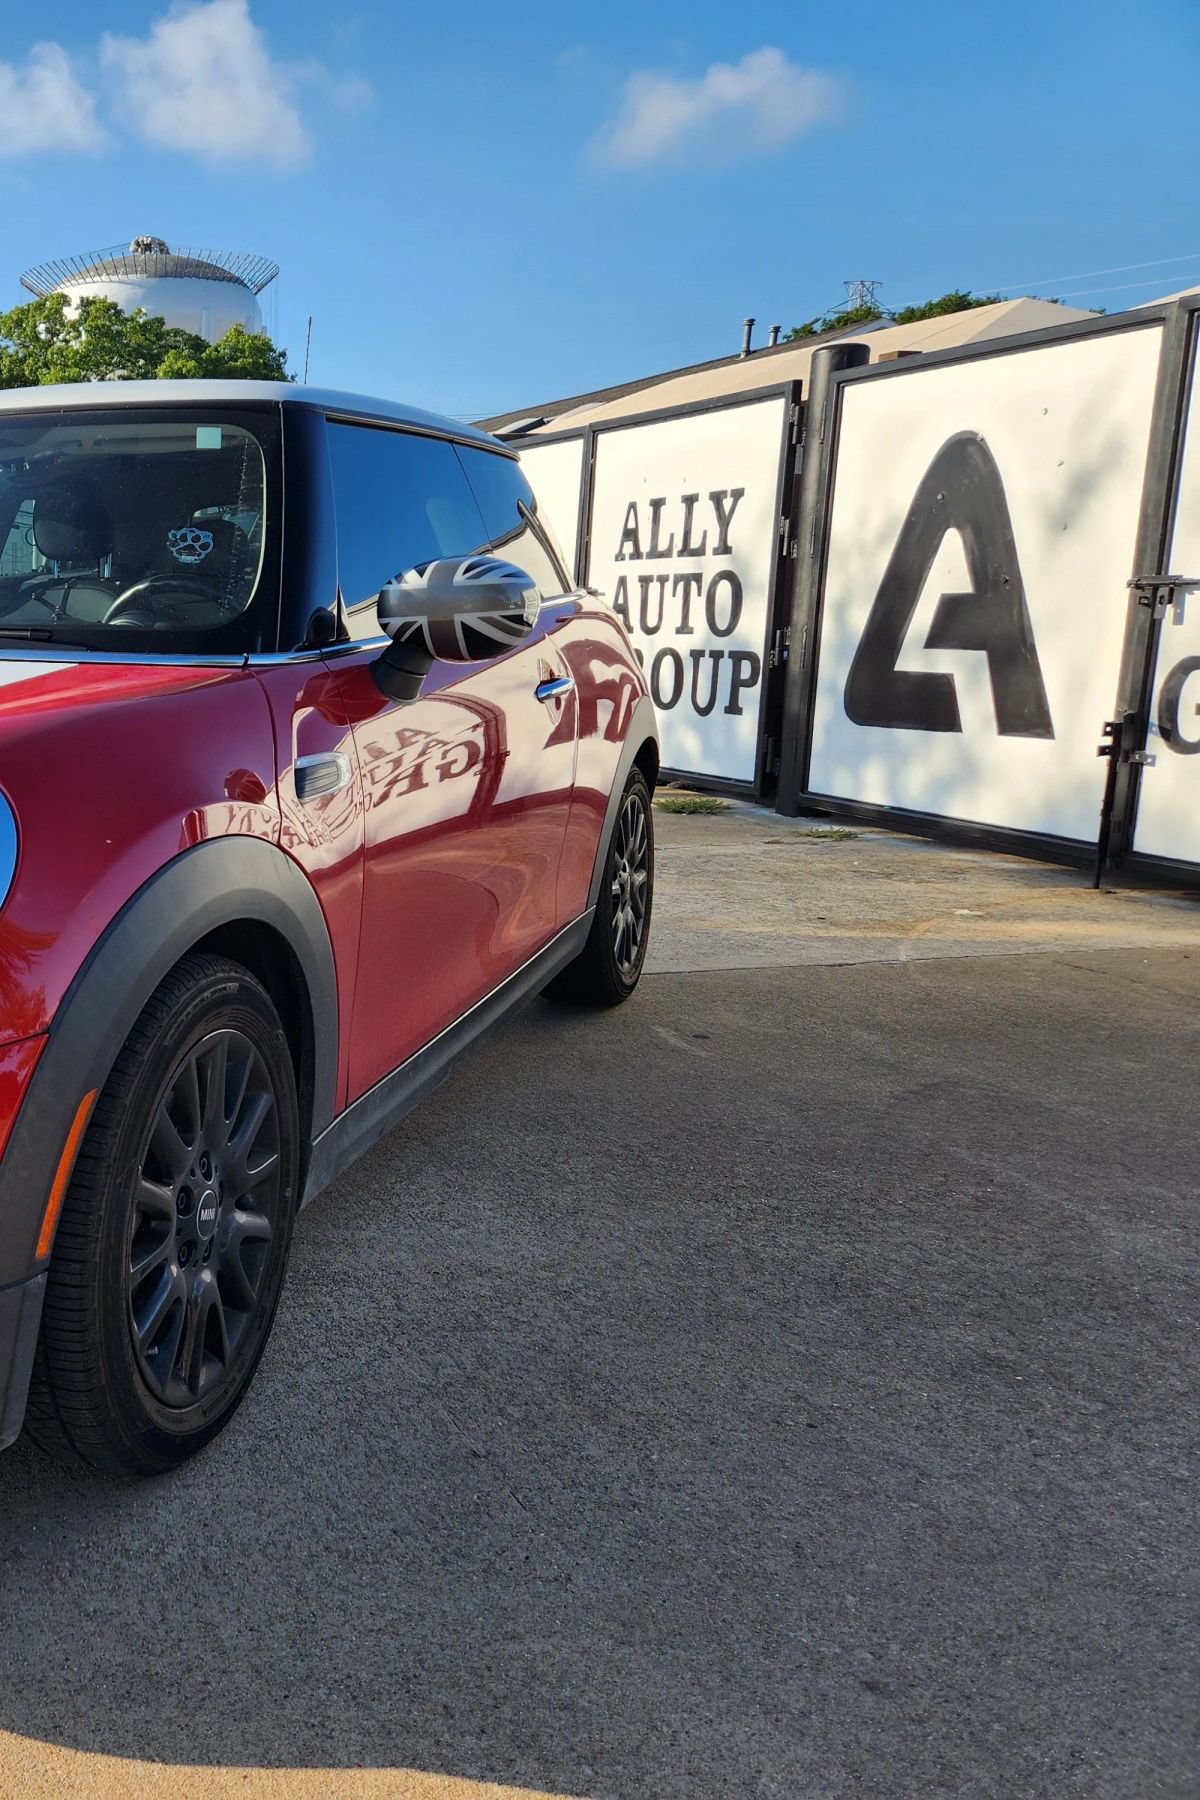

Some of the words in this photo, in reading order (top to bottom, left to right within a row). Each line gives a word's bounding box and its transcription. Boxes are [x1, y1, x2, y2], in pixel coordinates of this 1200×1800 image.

[615, 487, 745, 562] ALLY
[613, 569, 744, 638] AUTO
[844, 430, 1055, 740] A
[634, 646, 761, 717] OUP
[200, 1207, 216, 1221] MINI
